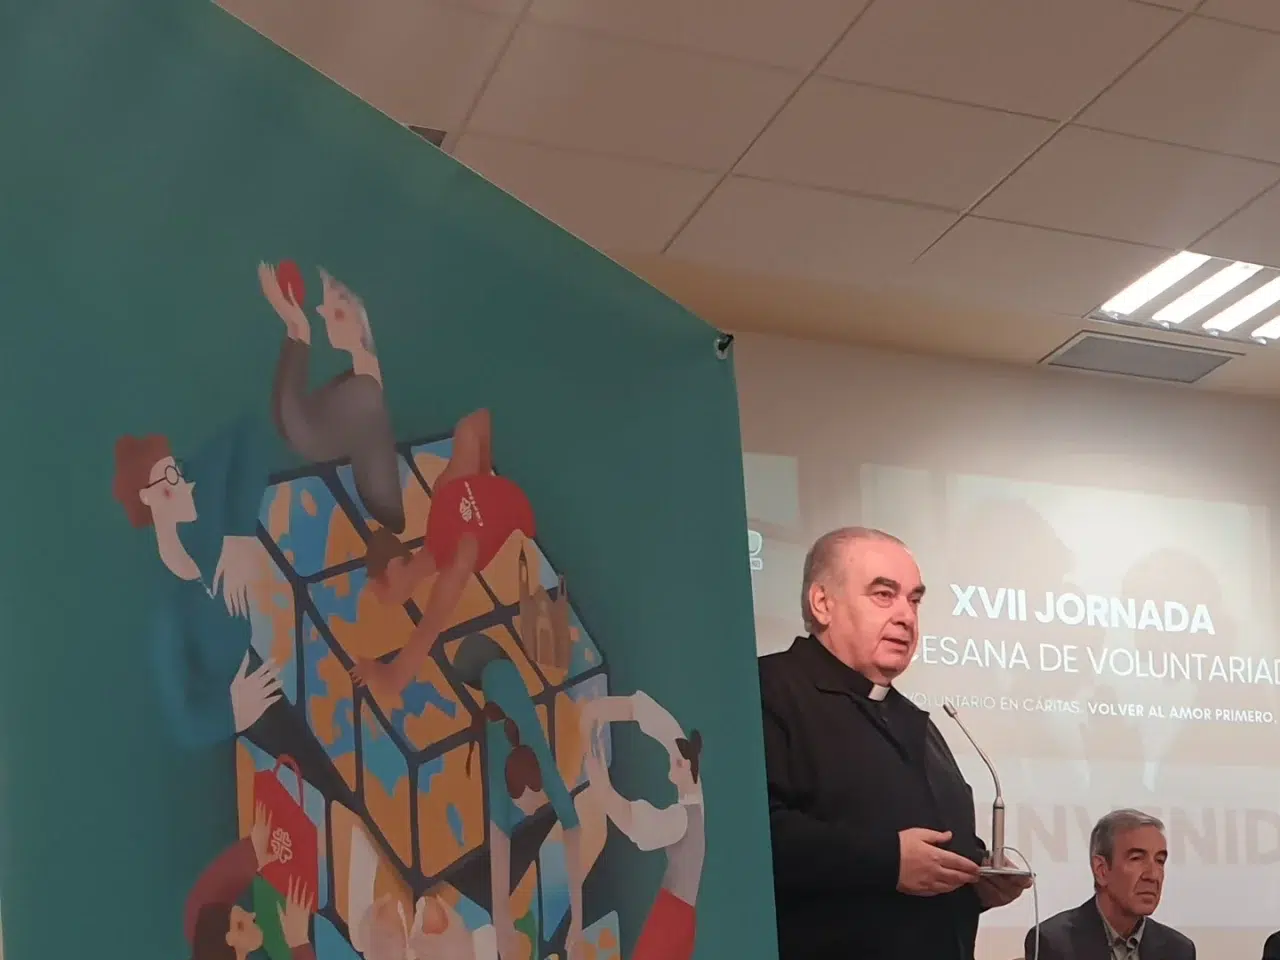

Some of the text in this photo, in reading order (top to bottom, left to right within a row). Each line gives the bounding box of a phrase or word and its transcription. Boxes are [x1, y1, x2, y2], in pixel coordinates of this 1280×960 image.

[950, 583, 1216, 636] XVII JORNADA
[911, 635, 1031, 670] ESANA
[1039, 643, 1079, 674] DE
[1000, 696, 1019, 711] EN
[1087, 700, 1144, 717] VOLVER
[1148, 705, 1165, 718] AL
[1169, 706, 1211, 721] AMOR
[1215, 708, 1277, 724] PRIMERO.
